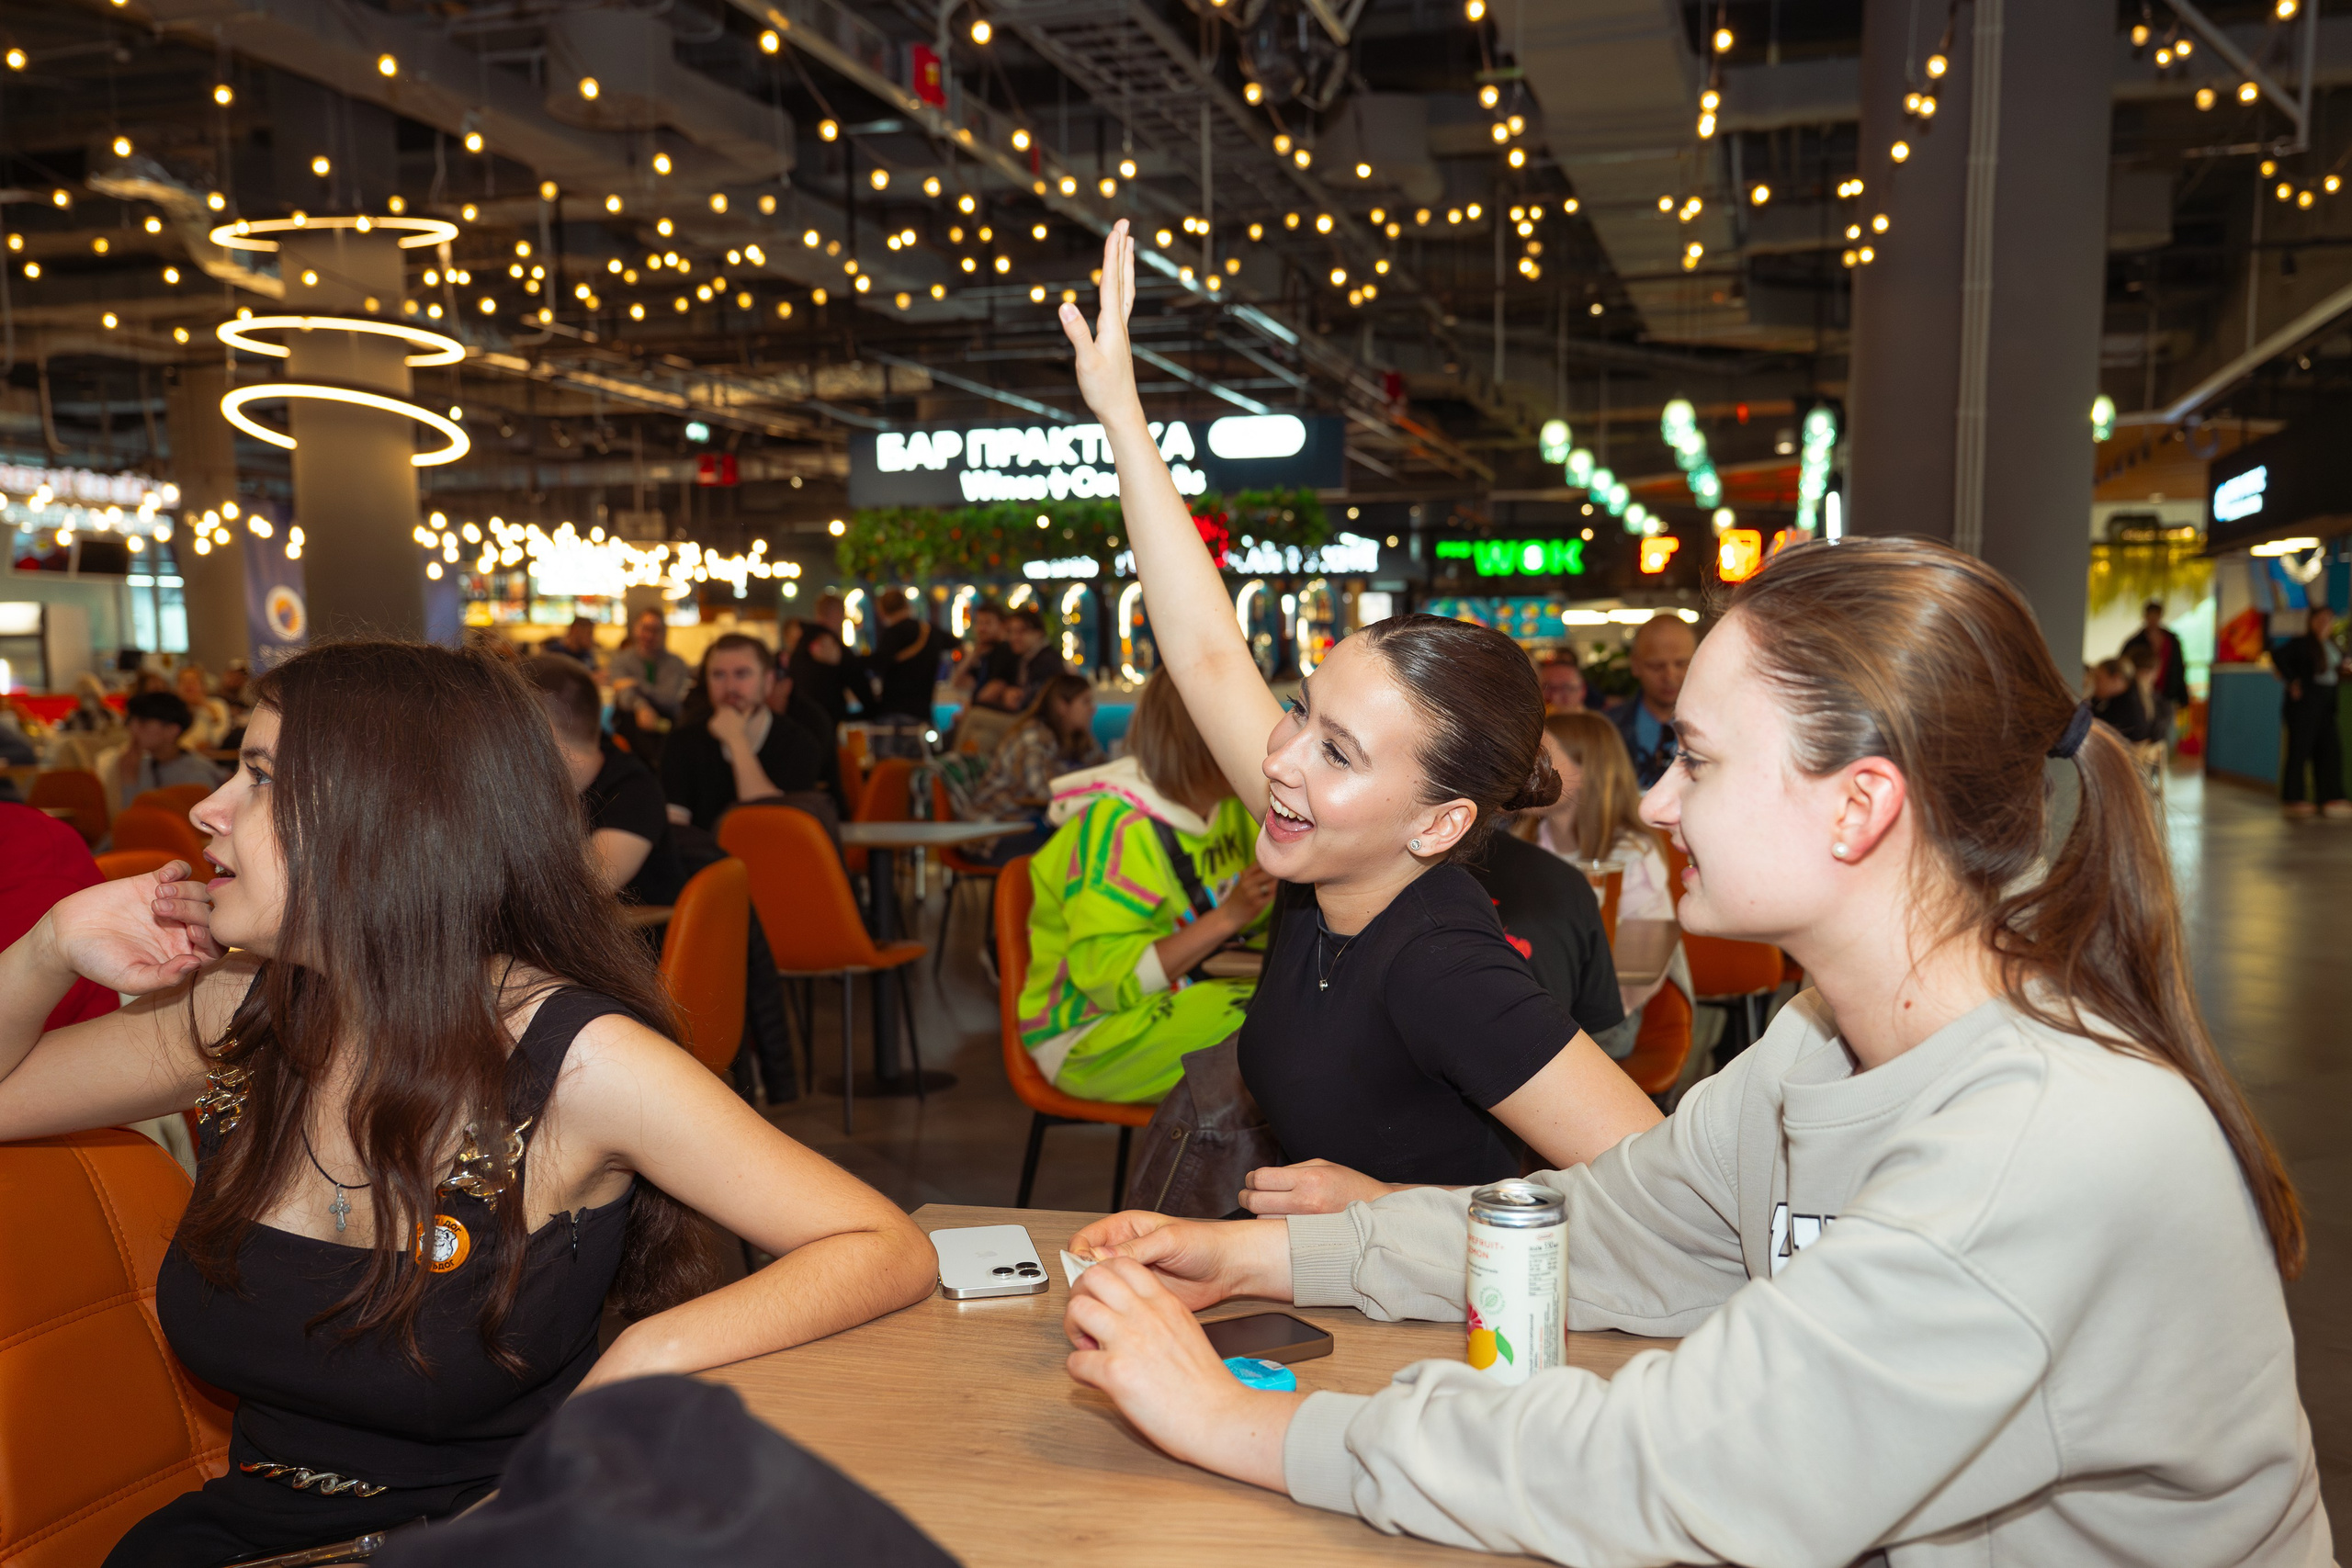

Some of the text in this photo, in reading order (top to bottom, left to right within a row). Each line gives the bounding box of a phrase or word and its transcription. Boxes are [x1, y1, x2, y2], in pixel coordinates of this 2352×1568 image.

[876, 421, 1195, 472] БАР ПРАКТА
[1474, 539, 1585, 576] WOK
